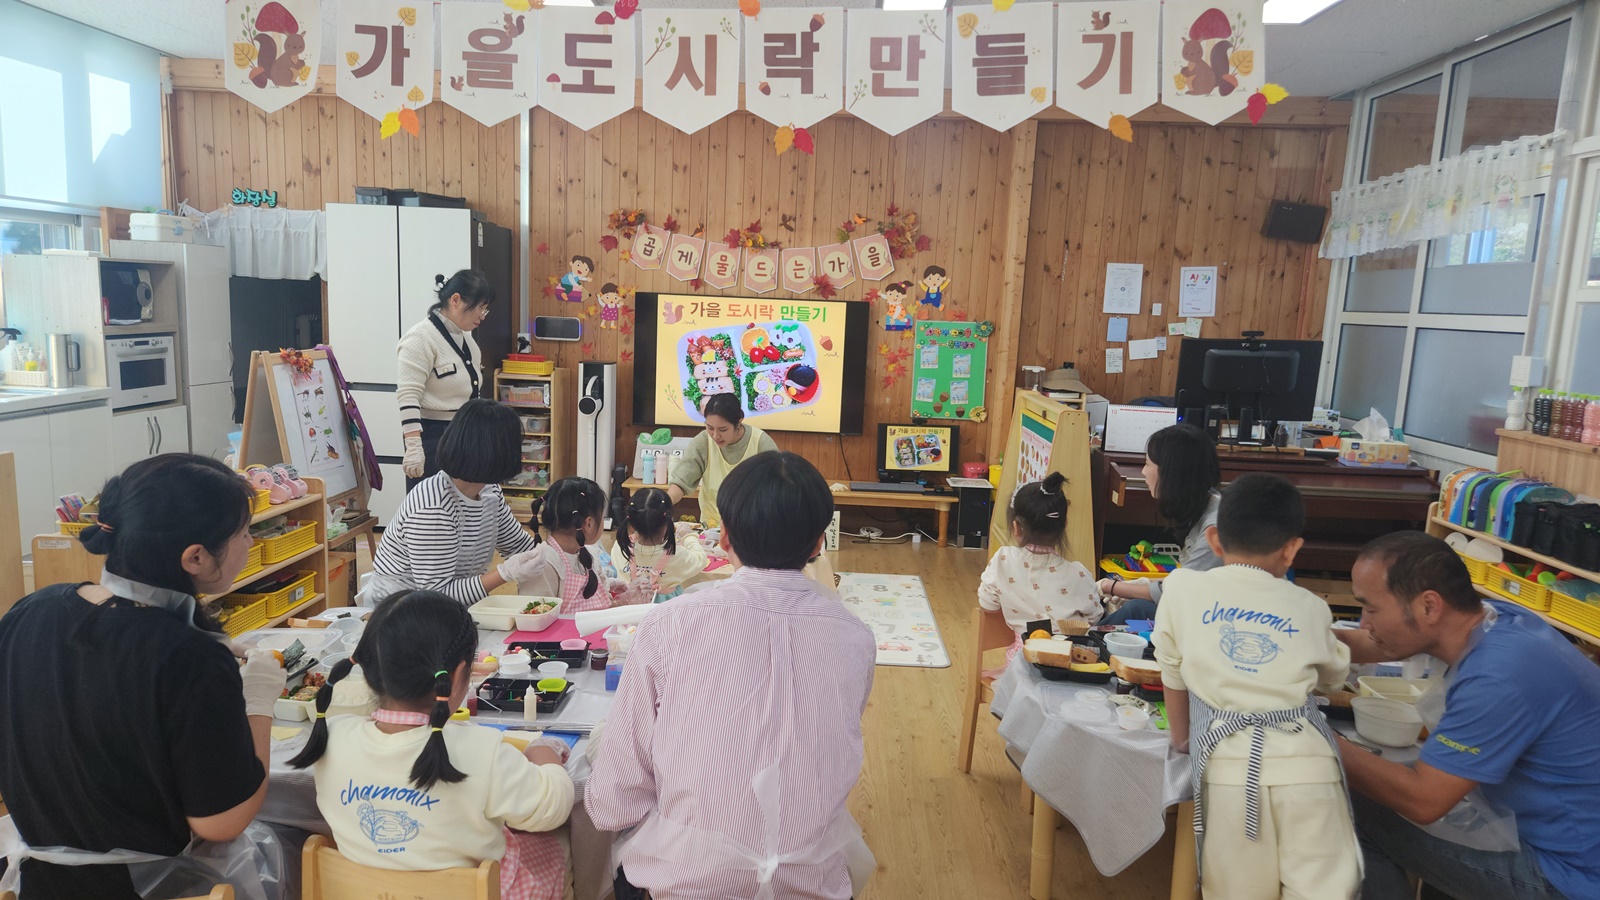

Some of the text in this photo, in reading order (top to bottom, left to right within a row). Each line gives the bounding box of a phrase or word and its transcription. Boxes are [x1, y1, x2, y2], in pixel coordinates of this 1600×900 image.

[232, 188, 277, 208] 화장실
[690, 301, 827, 322] 가을 도시락 만들기
[1202, 601, 1299, 638] chamonix
[1234, 665, 1258, 674] EIDER
[340, 779, 440, 811] chamonix
[377, 846, 406, 854] EIDER
